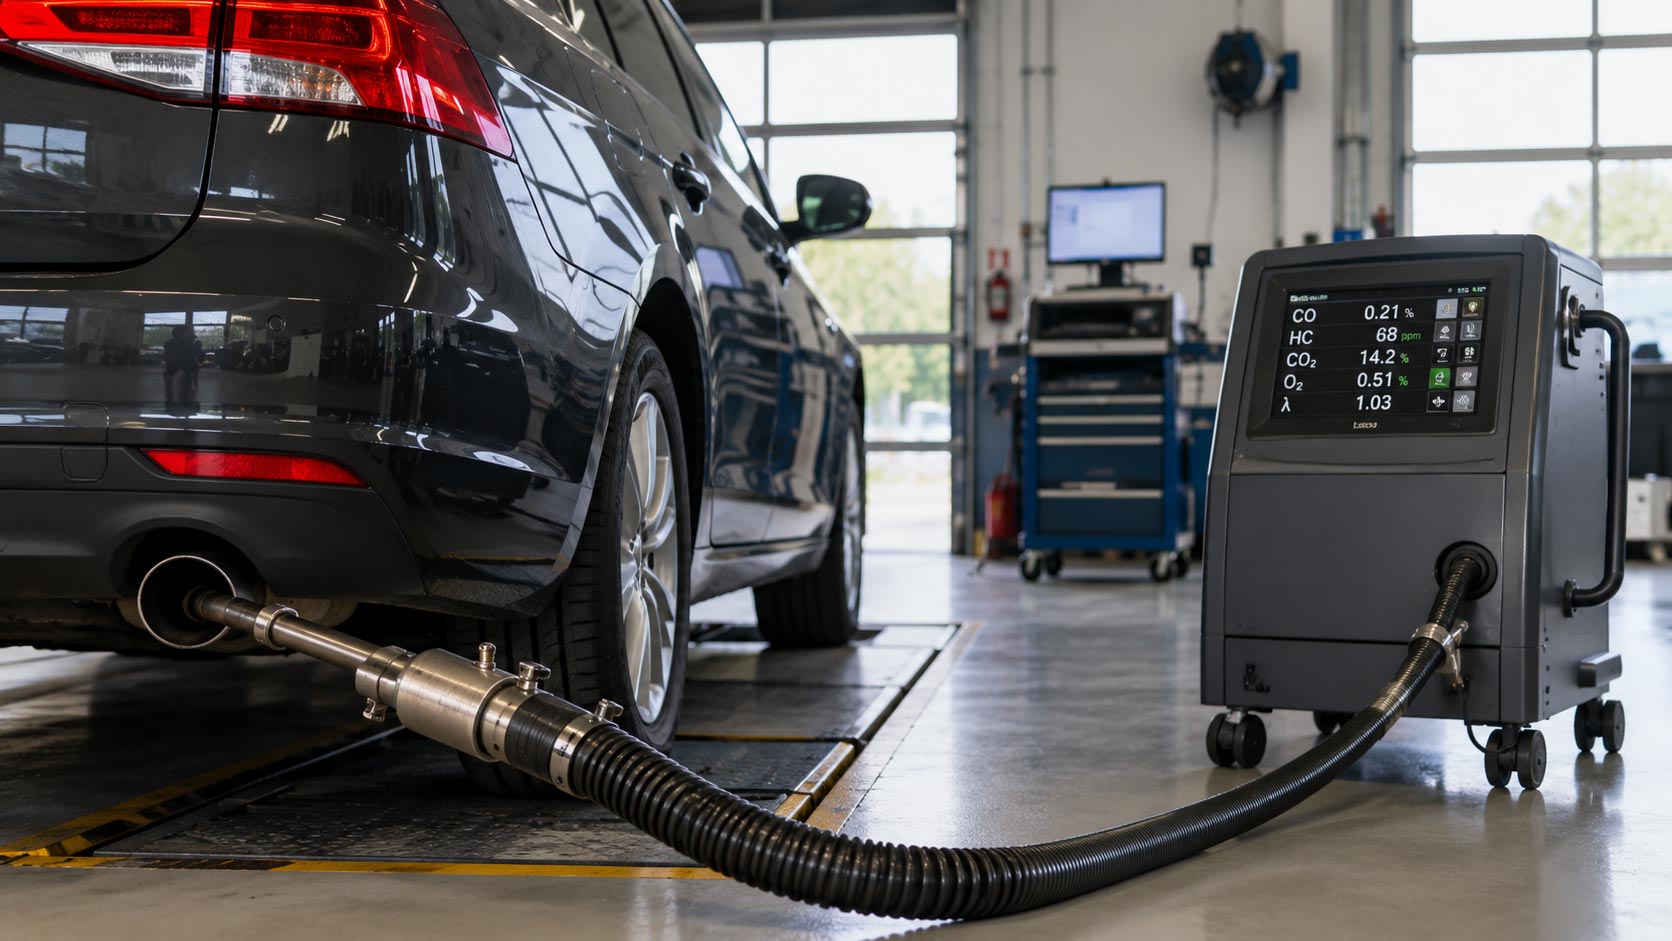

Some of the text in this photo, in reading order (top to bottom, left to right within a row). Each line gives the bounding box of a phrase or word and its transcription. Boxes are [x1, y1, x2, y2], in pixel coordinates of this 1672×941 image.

[1292, 304, 1415, 323] CO 0.21 %
[1289, 326, 1421, 345] HC 68 ppm
[1360, 348, 1396, 365] 14.2
[1400, 353, 1410, 364] %
[1357, 371, 1393, 388] 0.51
[1398, 375, 1409, 386] %
[1281, 394, 1392, 412] λ 1.03
